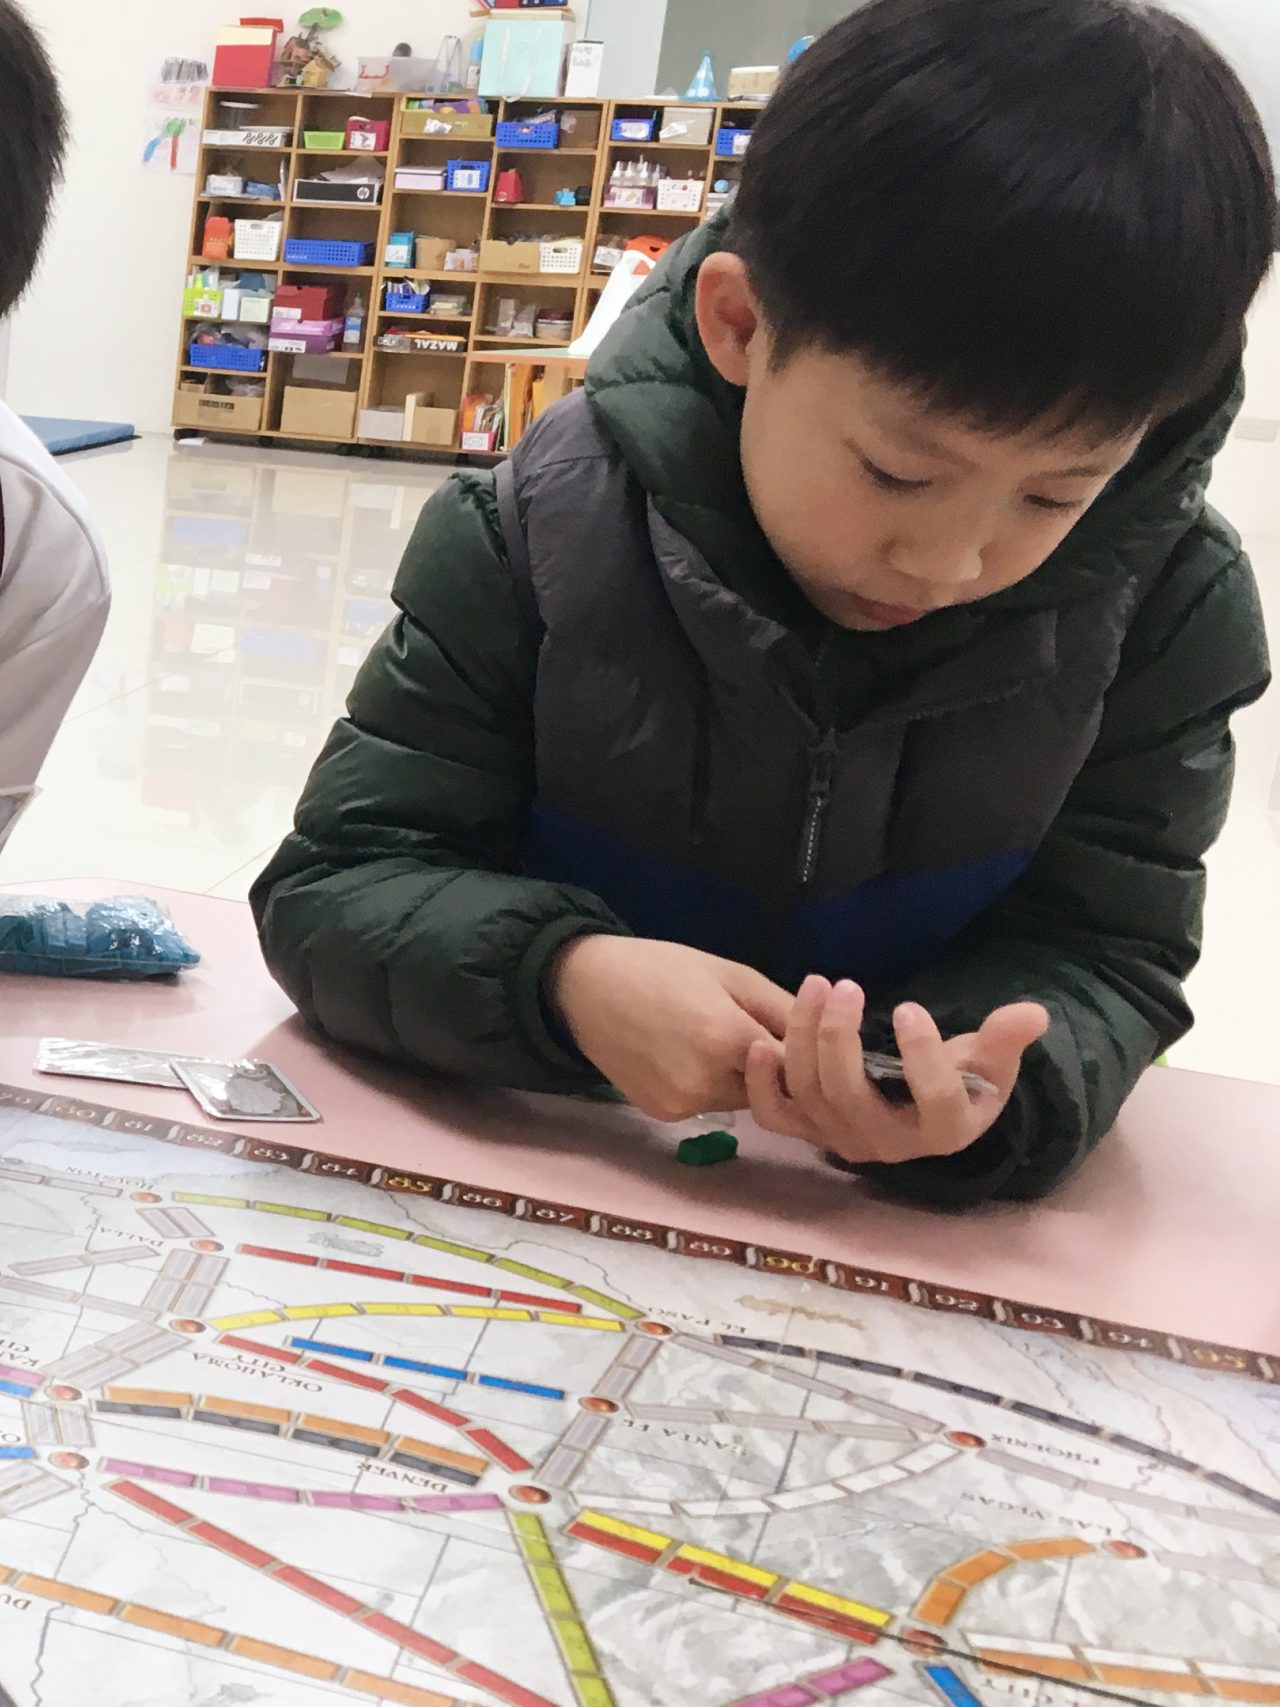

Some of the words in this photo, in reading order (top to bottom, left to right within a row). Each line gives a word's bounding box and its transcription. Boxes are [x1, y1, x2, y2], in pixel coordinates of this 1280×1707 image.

[84, 1223, 165, 1248] DALLAS
[190, 1352, 324, 1393] OKLAHOMA
[232, 1352, 286, 1373] CITY
[660, 1423, 748, 1457] SANTA
[989, 1433, 1100, 1467] PHOENIX
[353, 1460, 449, 1493] DENVER
[959, 1491, 1044, 1520] VEGAS
[1056, 1515, 1112, 1536] LAS
